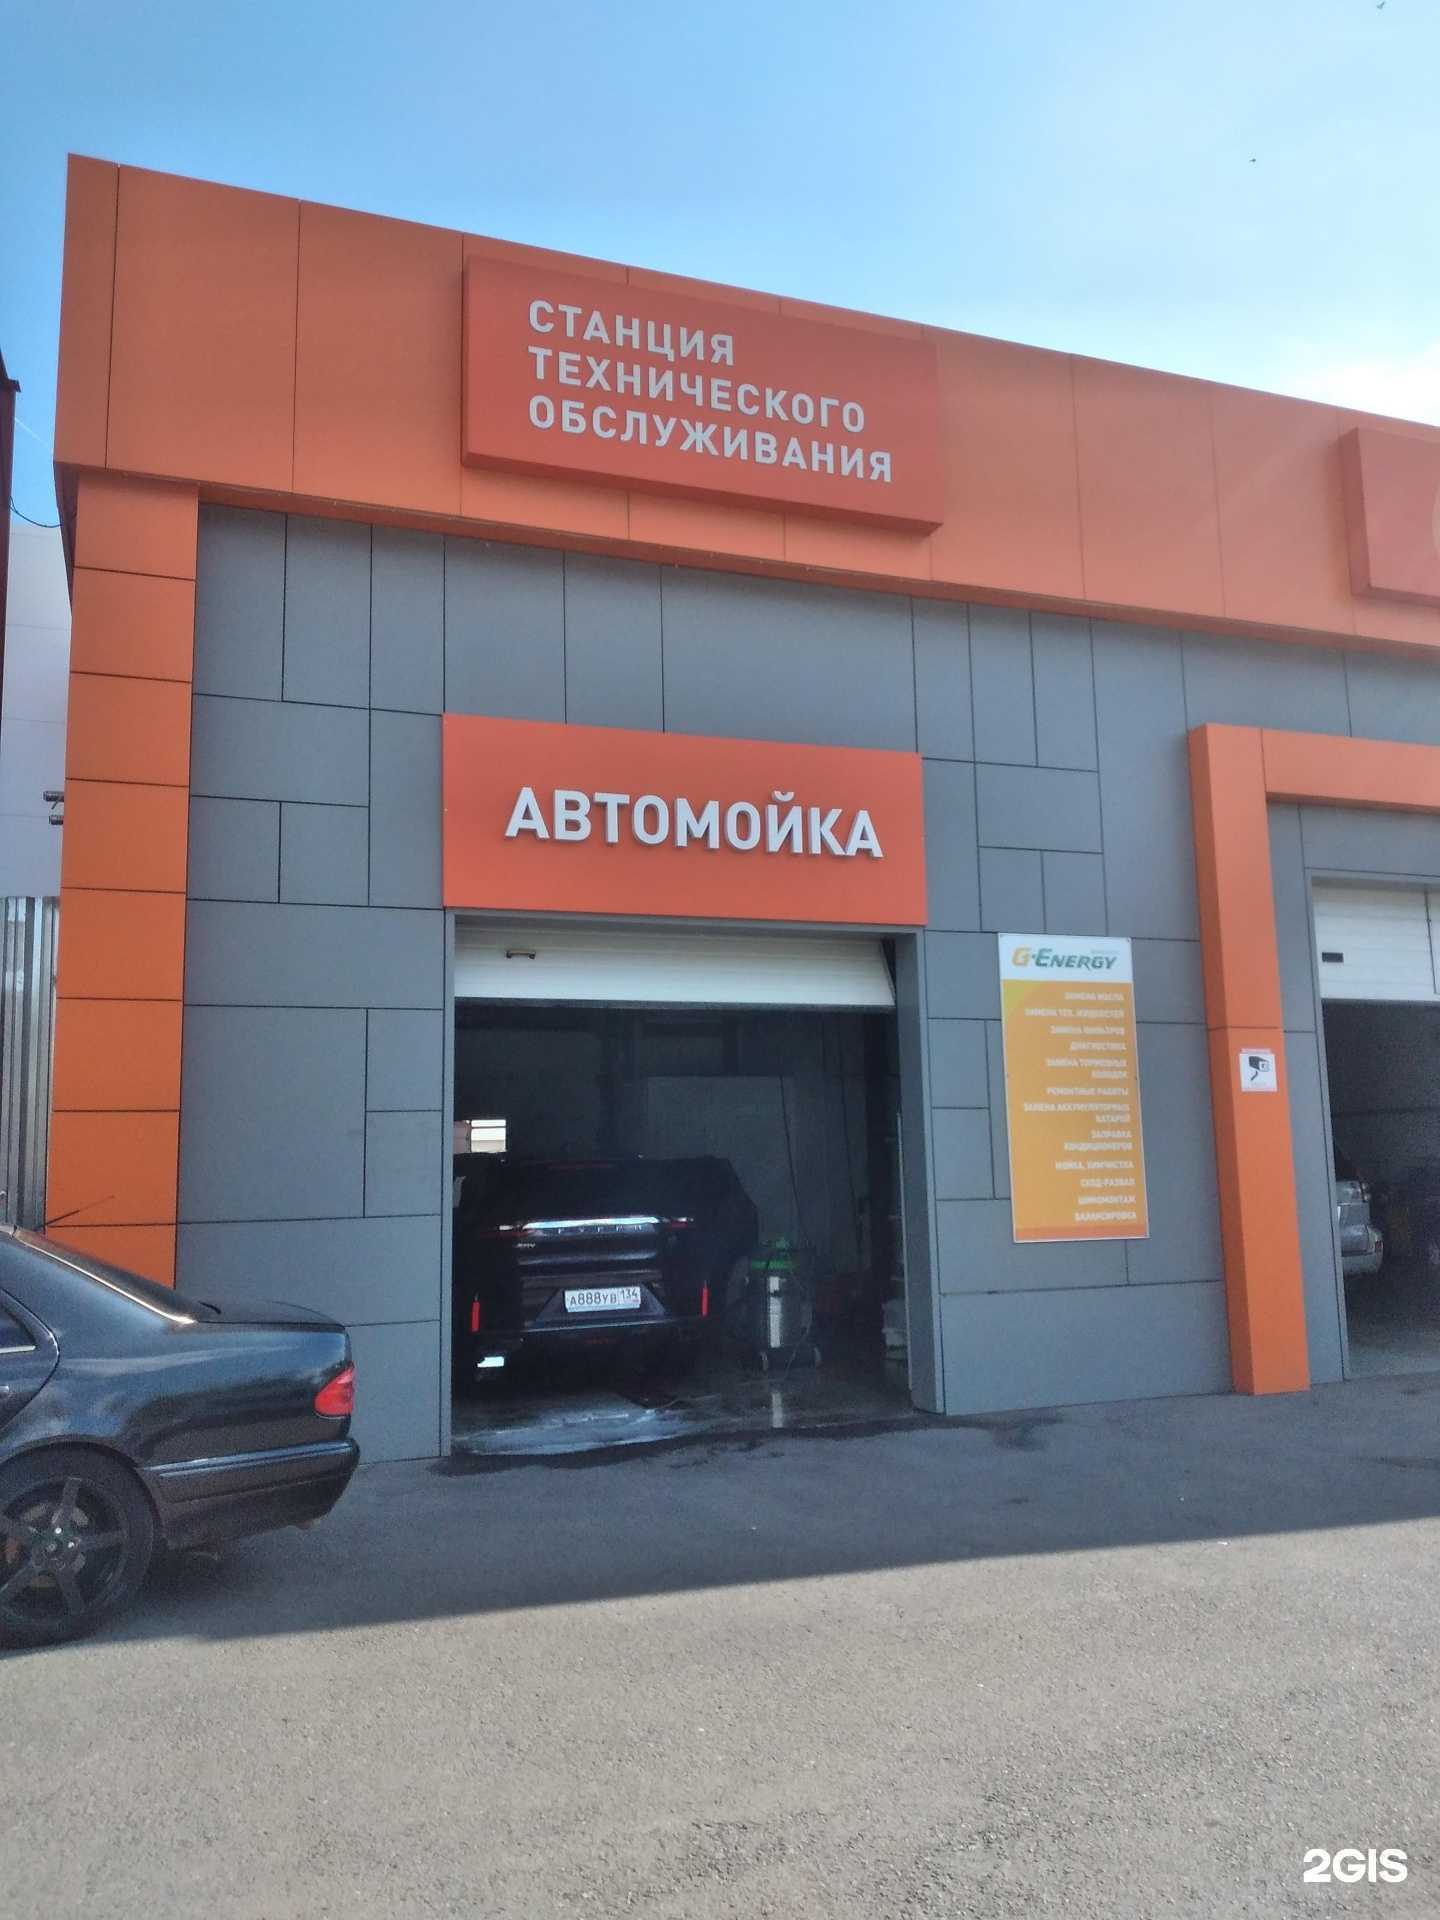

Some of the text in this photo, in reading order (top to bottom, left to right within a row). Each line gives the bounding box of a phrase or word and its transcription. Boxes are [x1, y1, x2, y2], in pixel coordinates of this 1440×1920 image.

[528, 299, 734, 366] СТАНЦИЯ
[527, 345, 865, 433] ТЕХНИЧЕСКОГО
[528, 394, 893, 483] ОБСЛУЖИВАНИЯ
[504, 786, 884, 859] АВТОМОЙКА
[620, 1286, 638, 1300] 134
